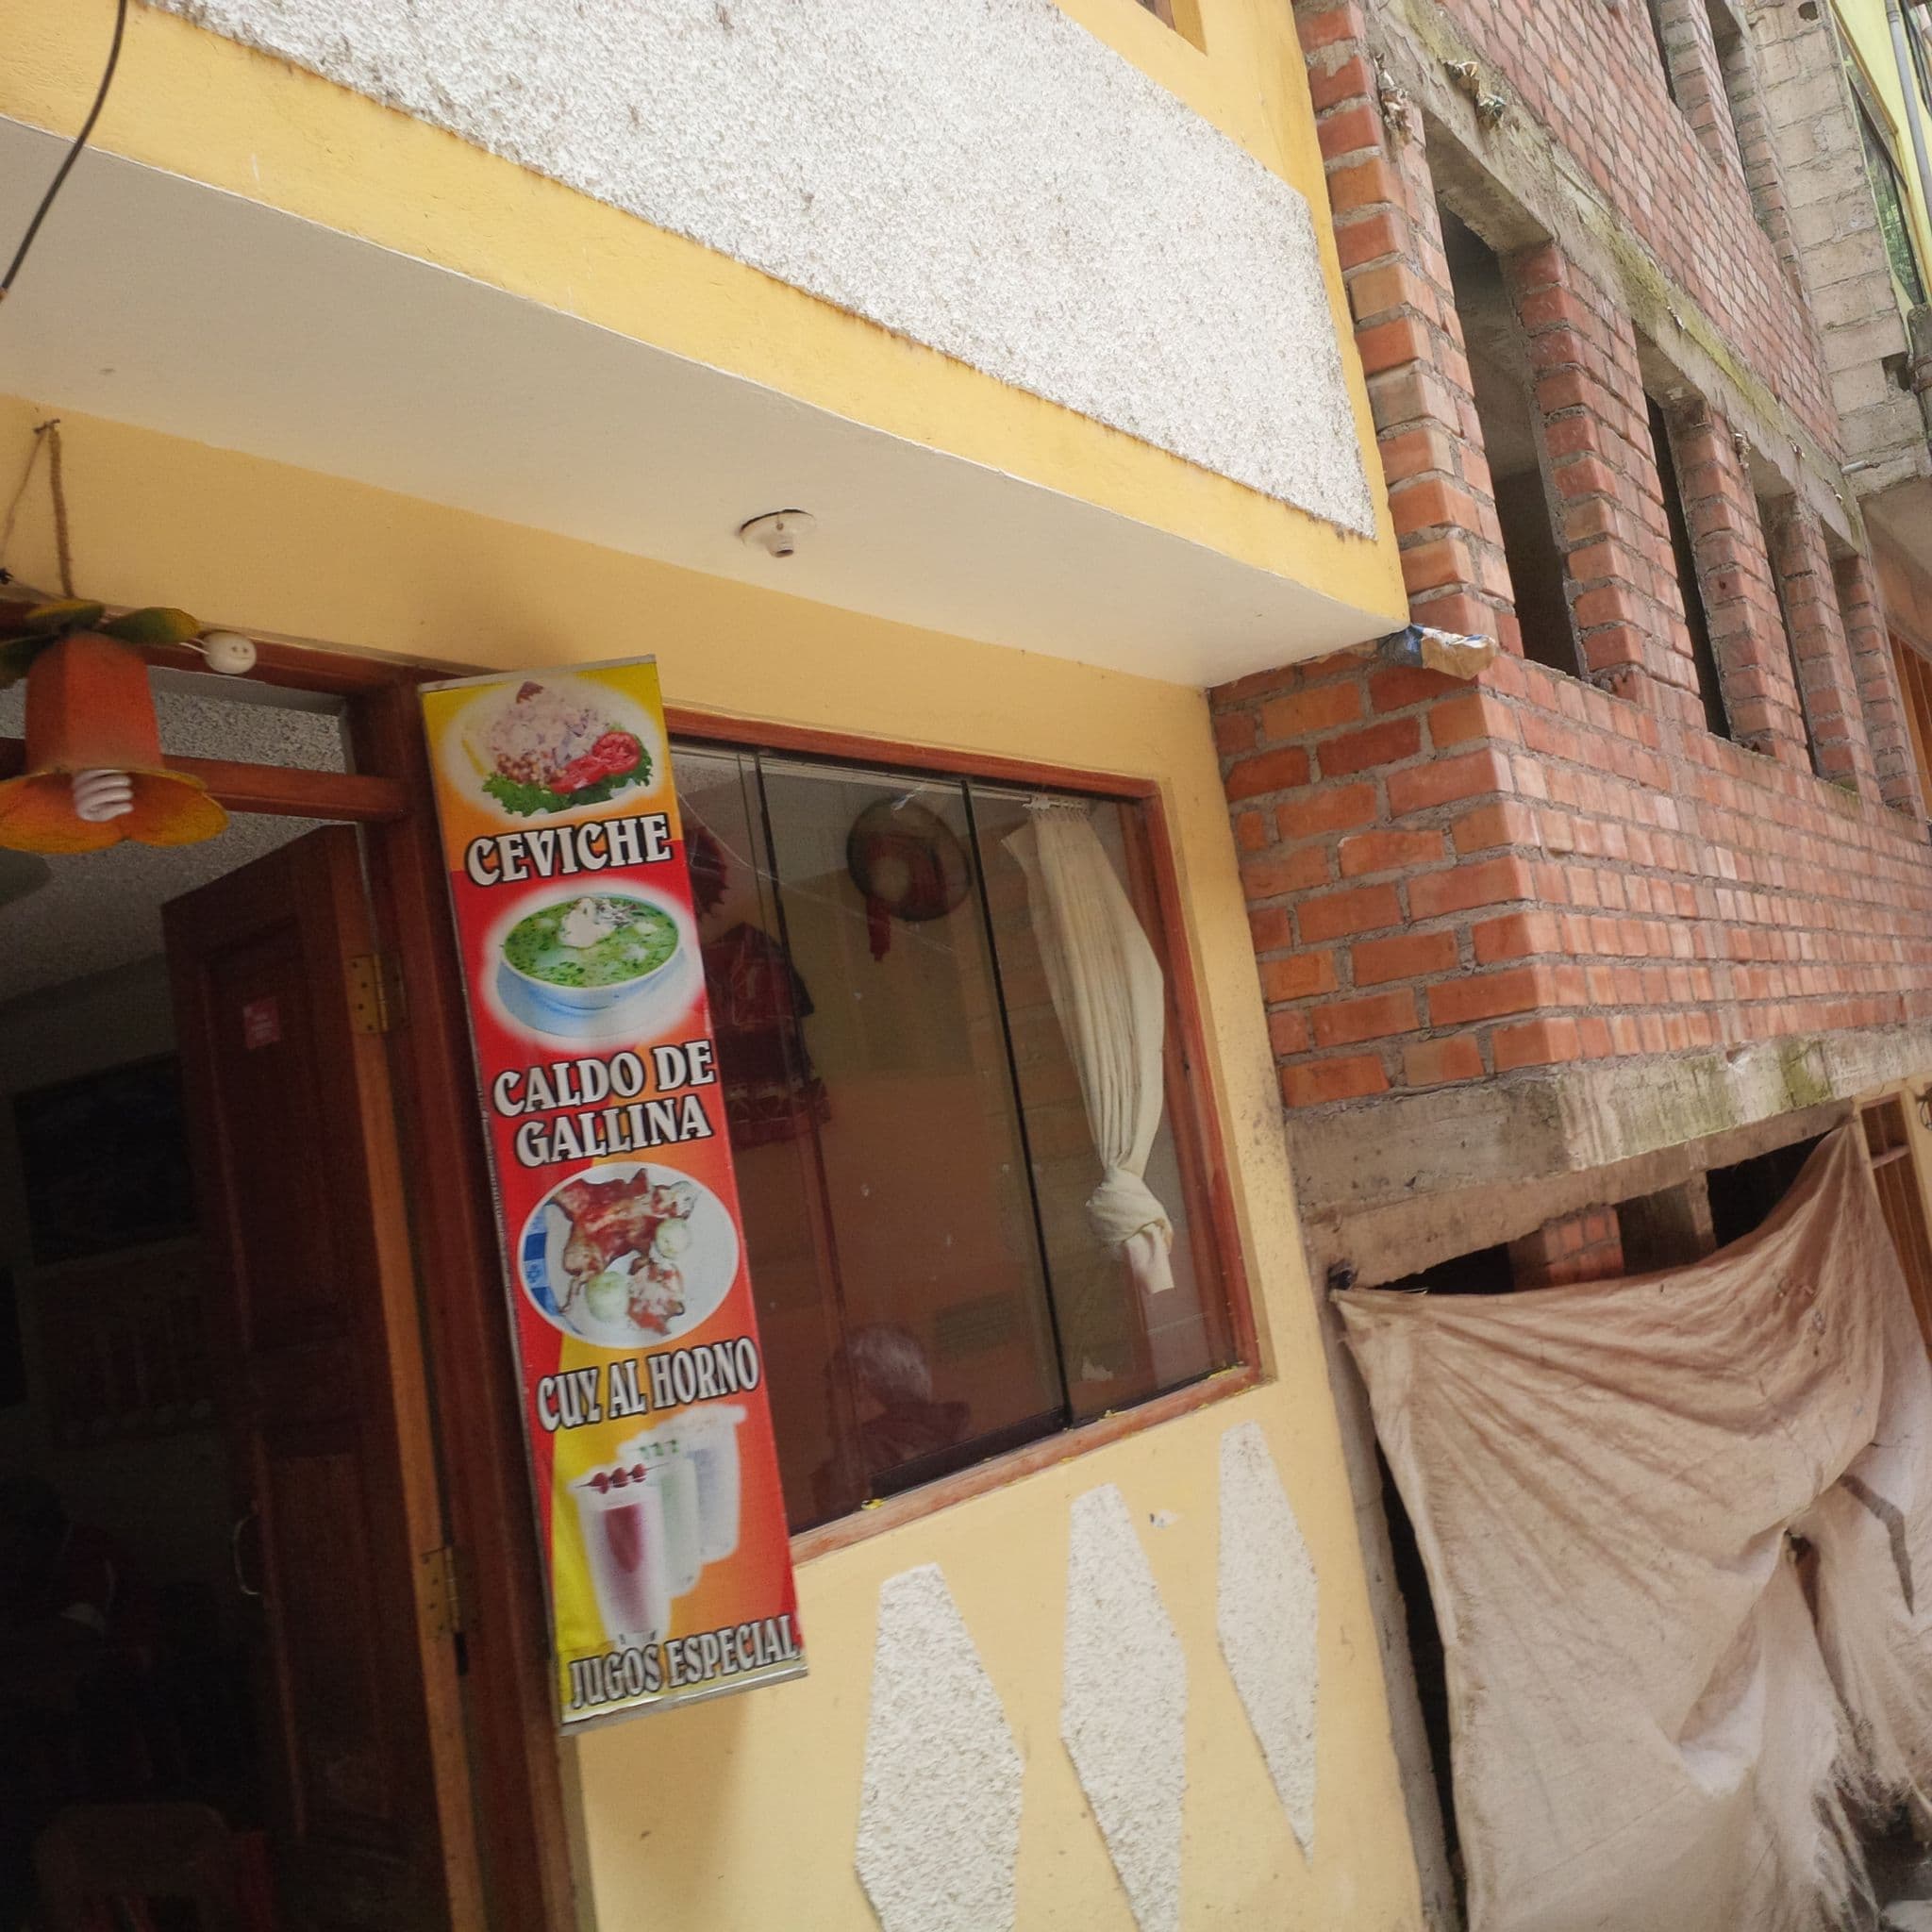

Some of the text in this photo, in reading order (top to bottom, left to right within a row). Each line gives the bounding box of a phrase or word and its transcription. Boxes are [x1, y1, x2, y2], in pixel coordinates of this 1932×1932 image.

[466, 813, 673, 886] CEVICHE
[492, 1039, 717, 1117] CALDO DE
[515, 1094, 713, 1167] GALLINA
[537, 1336, 759, 1431] CUY AL HORNO
[570, 1614, 801, 1708] JUGOS ESPECIAL
